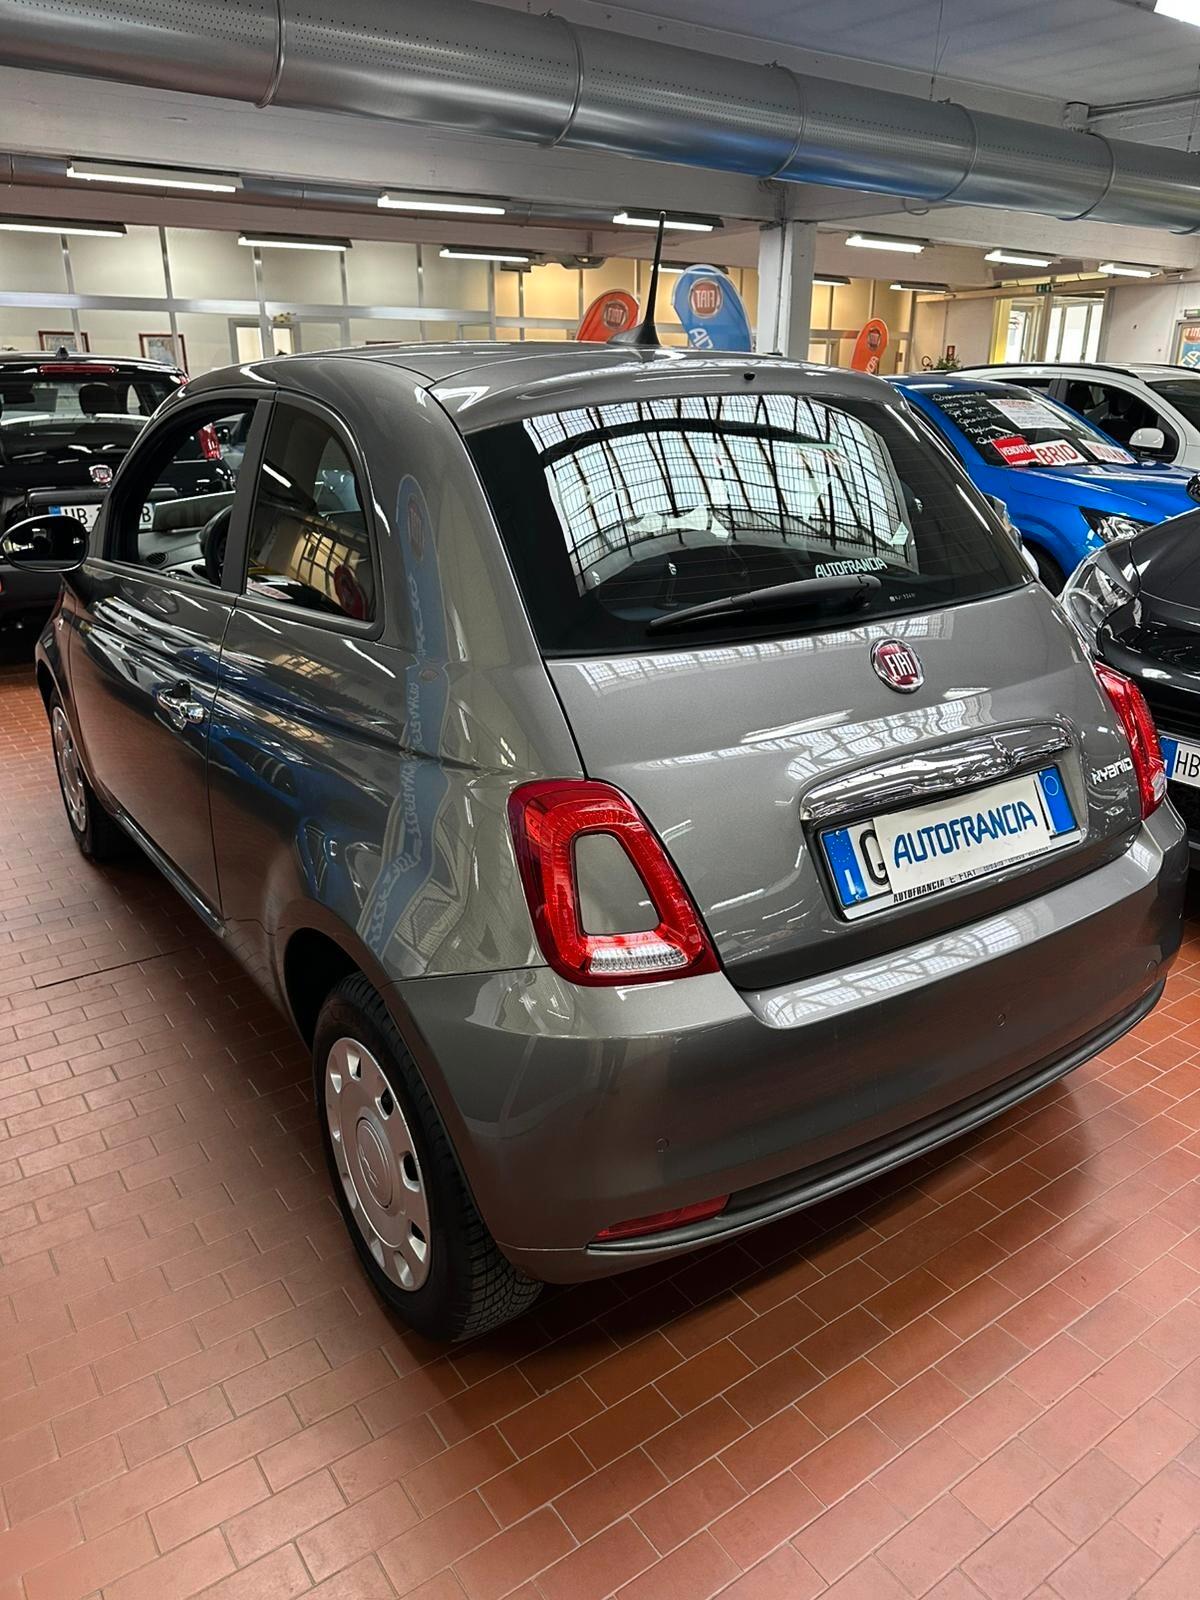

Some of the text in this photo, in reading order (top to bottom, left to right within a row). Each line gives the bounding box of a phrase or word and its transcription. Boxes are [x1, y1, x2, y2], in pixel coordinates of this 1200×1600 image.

[815, 557, 889, 578] AUTOFRANCIA
[884, 651, 916, 679] FIAT
[893, 801, 1039, 869] AUTOFRANCIA
[893, 879, 945, 903] AUTOFRANCIA
